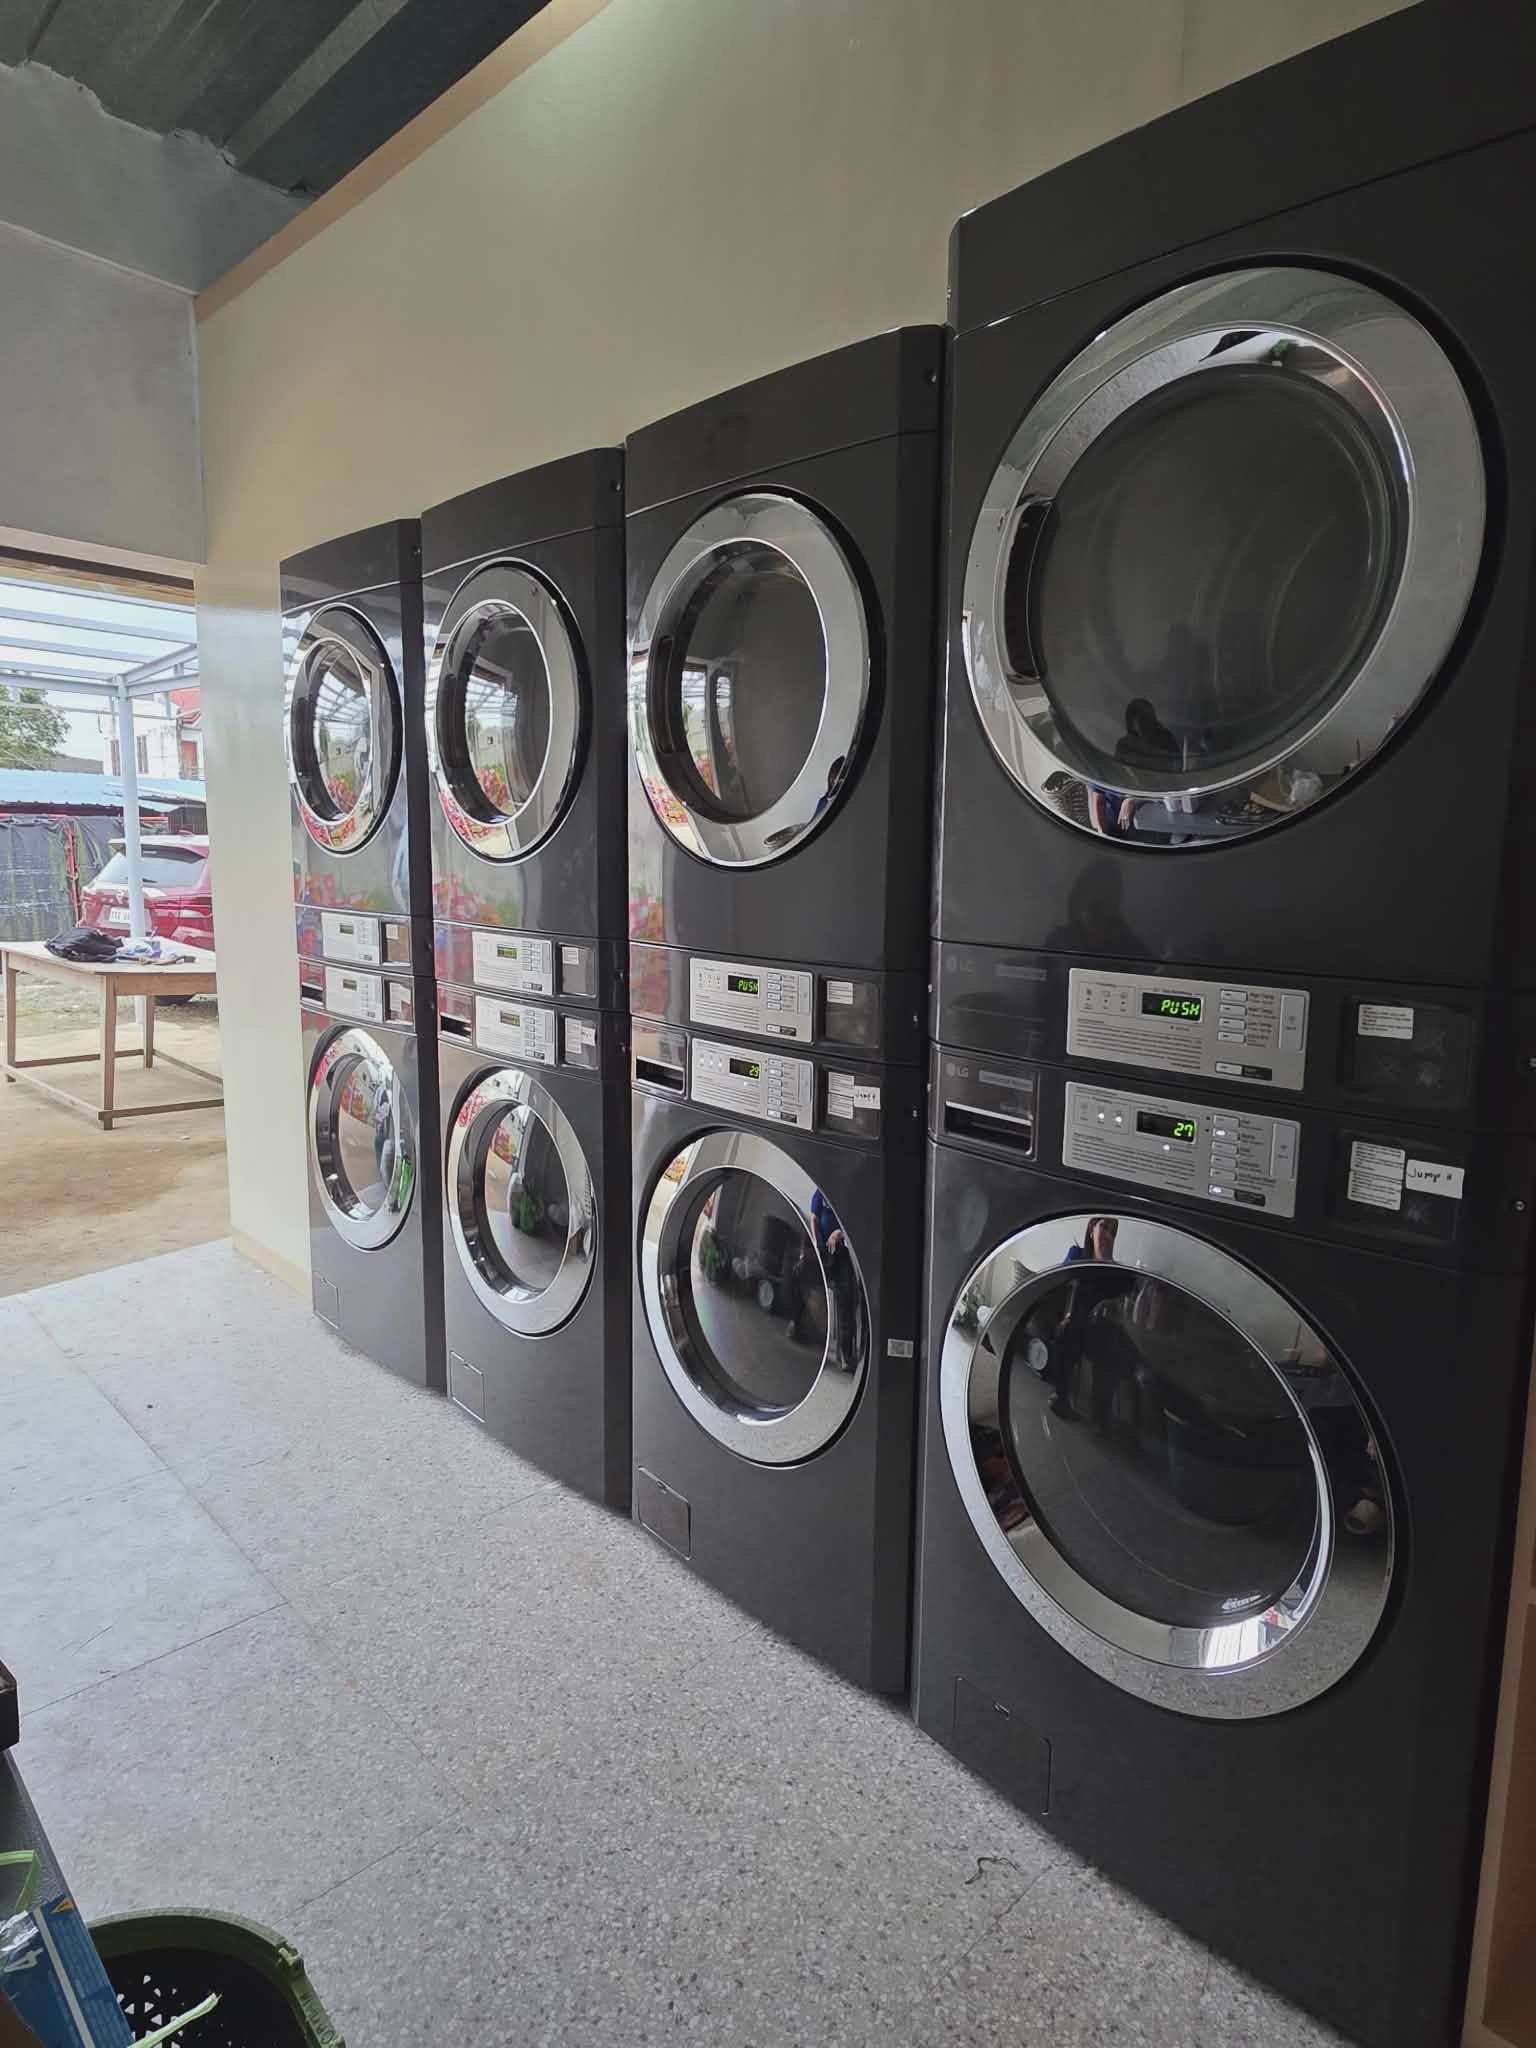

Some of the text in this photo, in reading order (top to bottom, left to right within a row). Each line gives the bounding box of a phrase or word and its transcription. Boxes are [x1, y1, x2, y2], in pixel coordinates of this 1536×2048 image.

[738, 980, 759, 992] PUSH
[1160, 999, 1200, 1016] PUSH
[1173, 1122, 1194, 1137] 27
[1408, 1167, 1441, 1183] Jump
